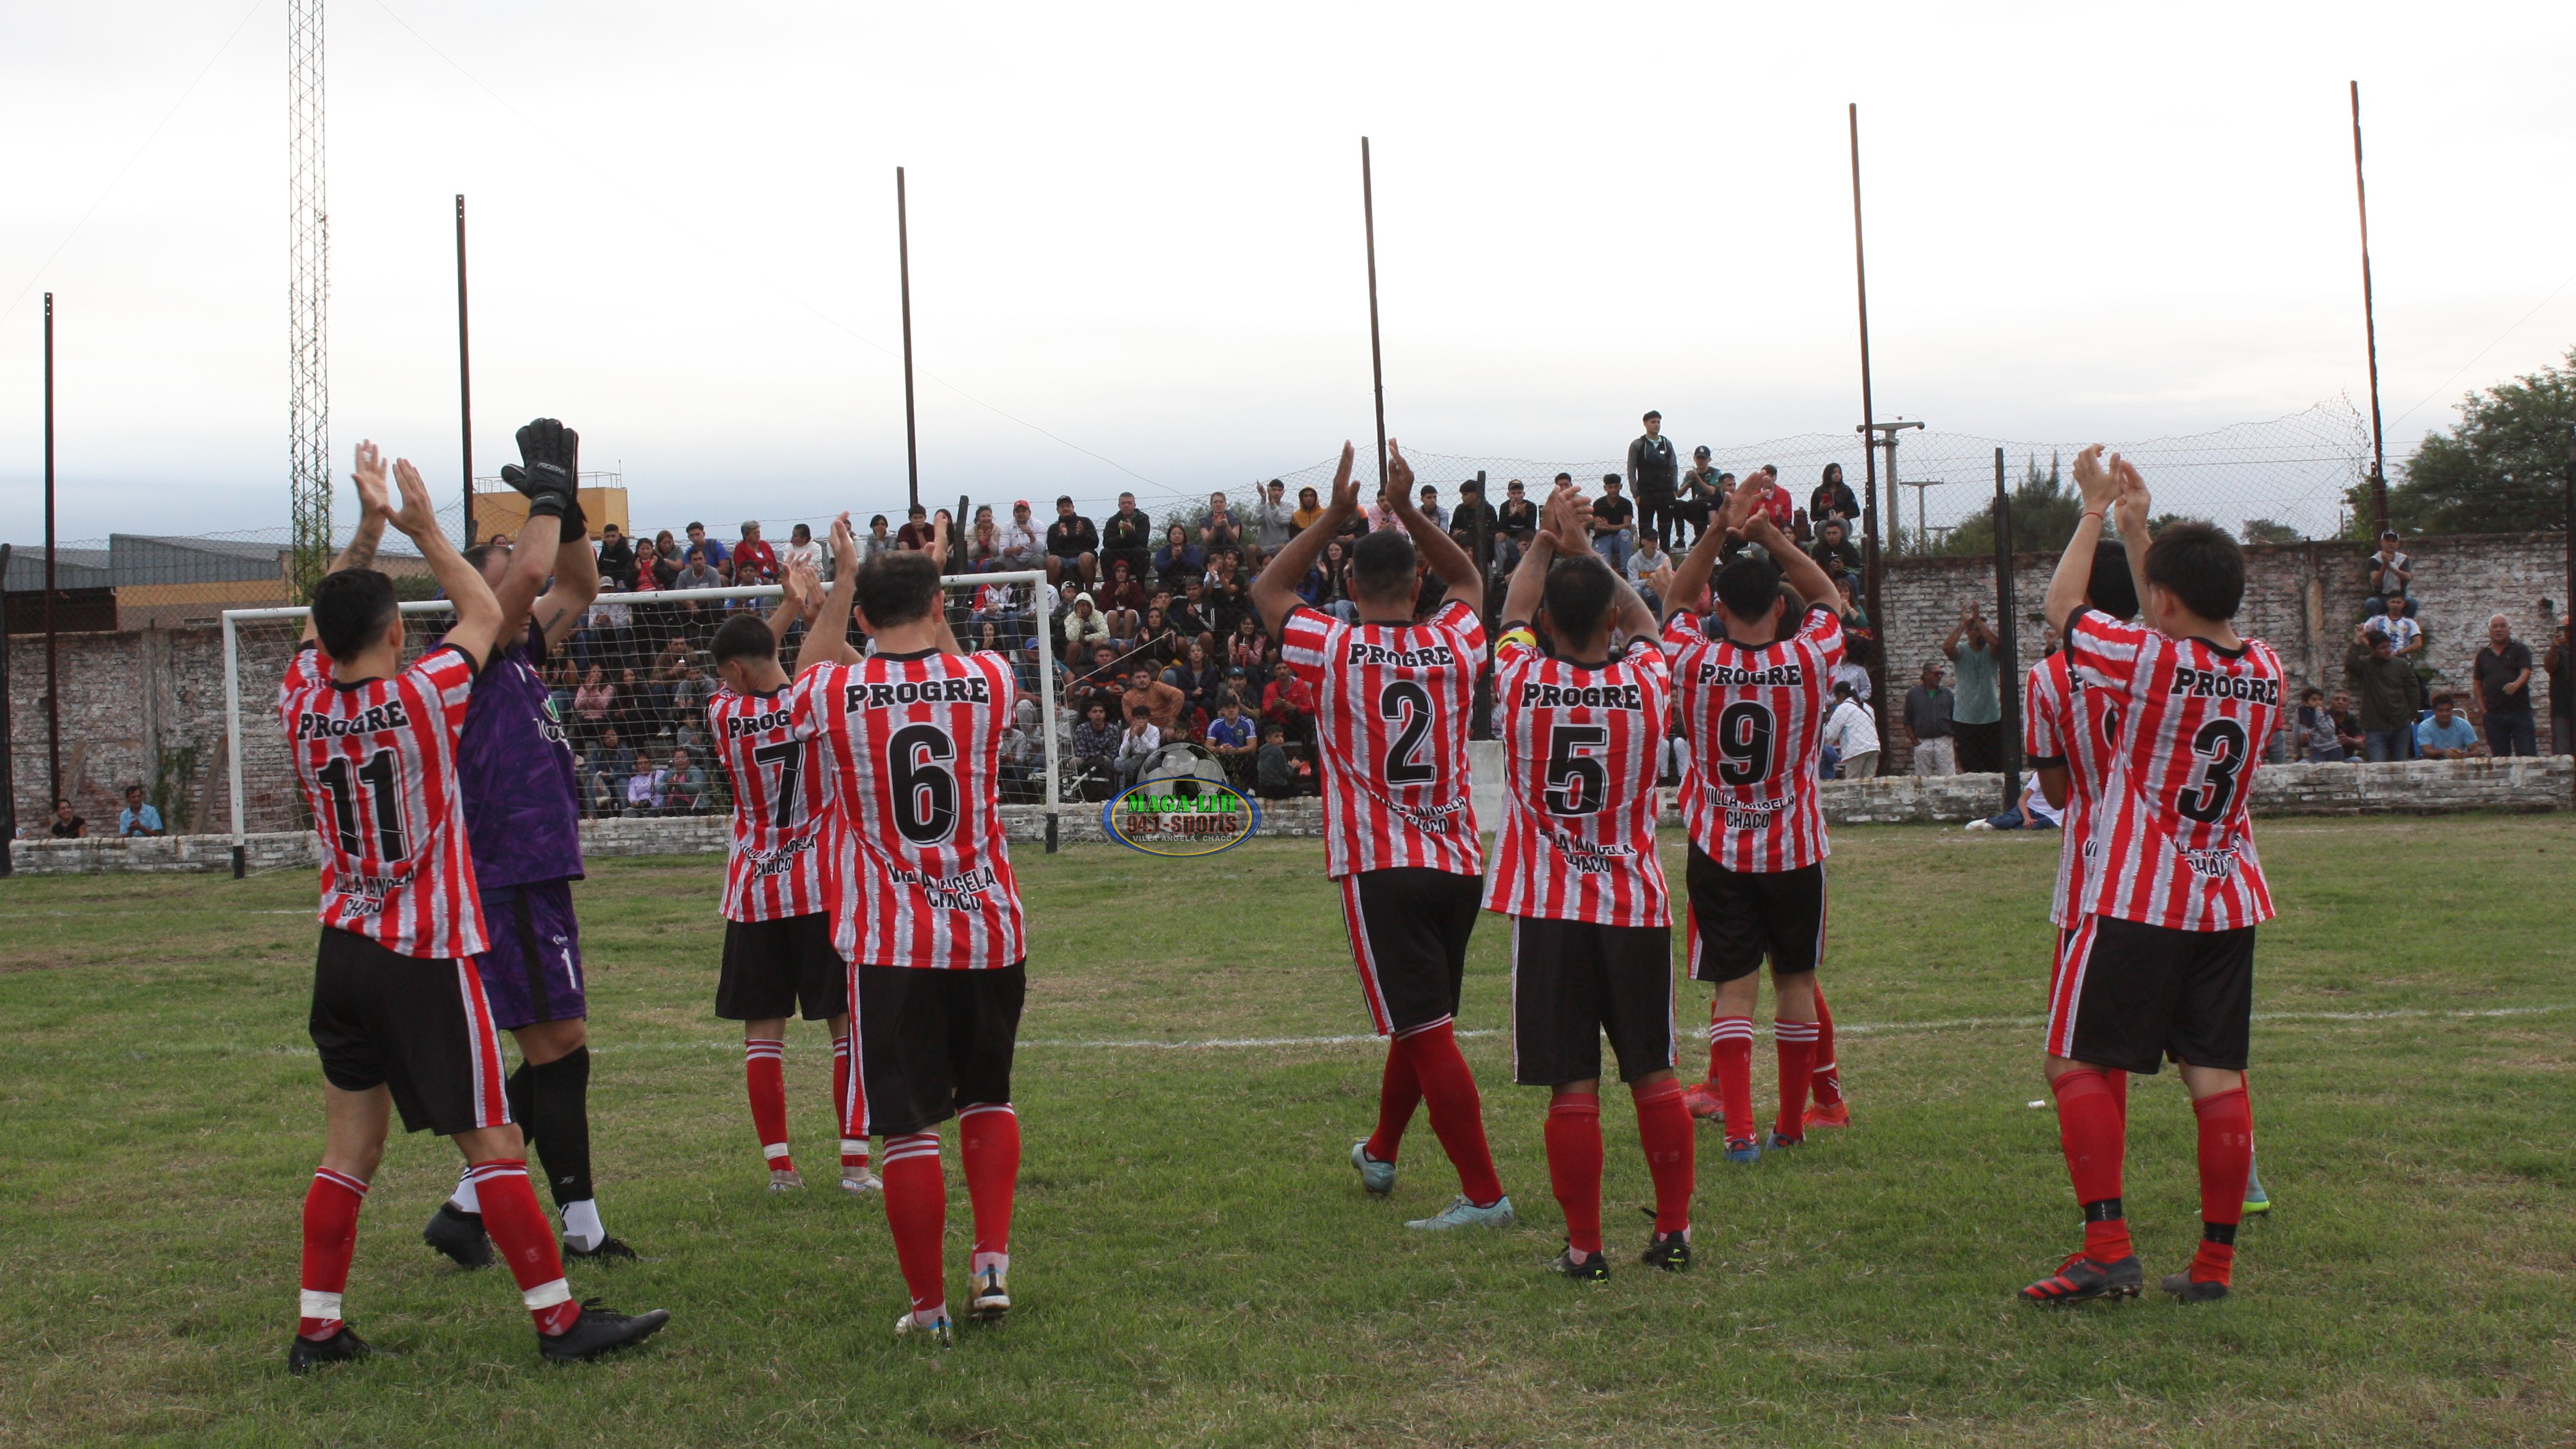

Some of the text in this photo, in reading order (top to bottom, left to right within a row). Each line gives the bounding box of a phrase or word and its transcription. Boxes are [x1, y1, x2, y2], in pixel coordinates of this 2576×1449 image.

[537, 462, 566, 475] PROSTAR
[1348, 642, 1456, 667] PROGRE
[1697, 662, 1803, 686] PROGRE
[844, 676, 989, 713] PROGRE
[1521, 683, 1642, 712] PROGRE
[2170, 667, 2279, 707] PROGRE
[297, 700, 410, 740] PROGRE
[1379, 680, 1437, 785] 2
[1717, 700, 1776, 786] 9
[754, 741, 805, 829] 7
[886, 722, 959, 847] 6
[1545, 724, 1610, 816] 5
[2176, 716, 2249, 824] 3
[317, 747, 411, 864] 11
[1703, 787, 1738, 808] VILLA
[1726, 810, 1770, 829] CHACO
[561, 948, 577, 990] 1
